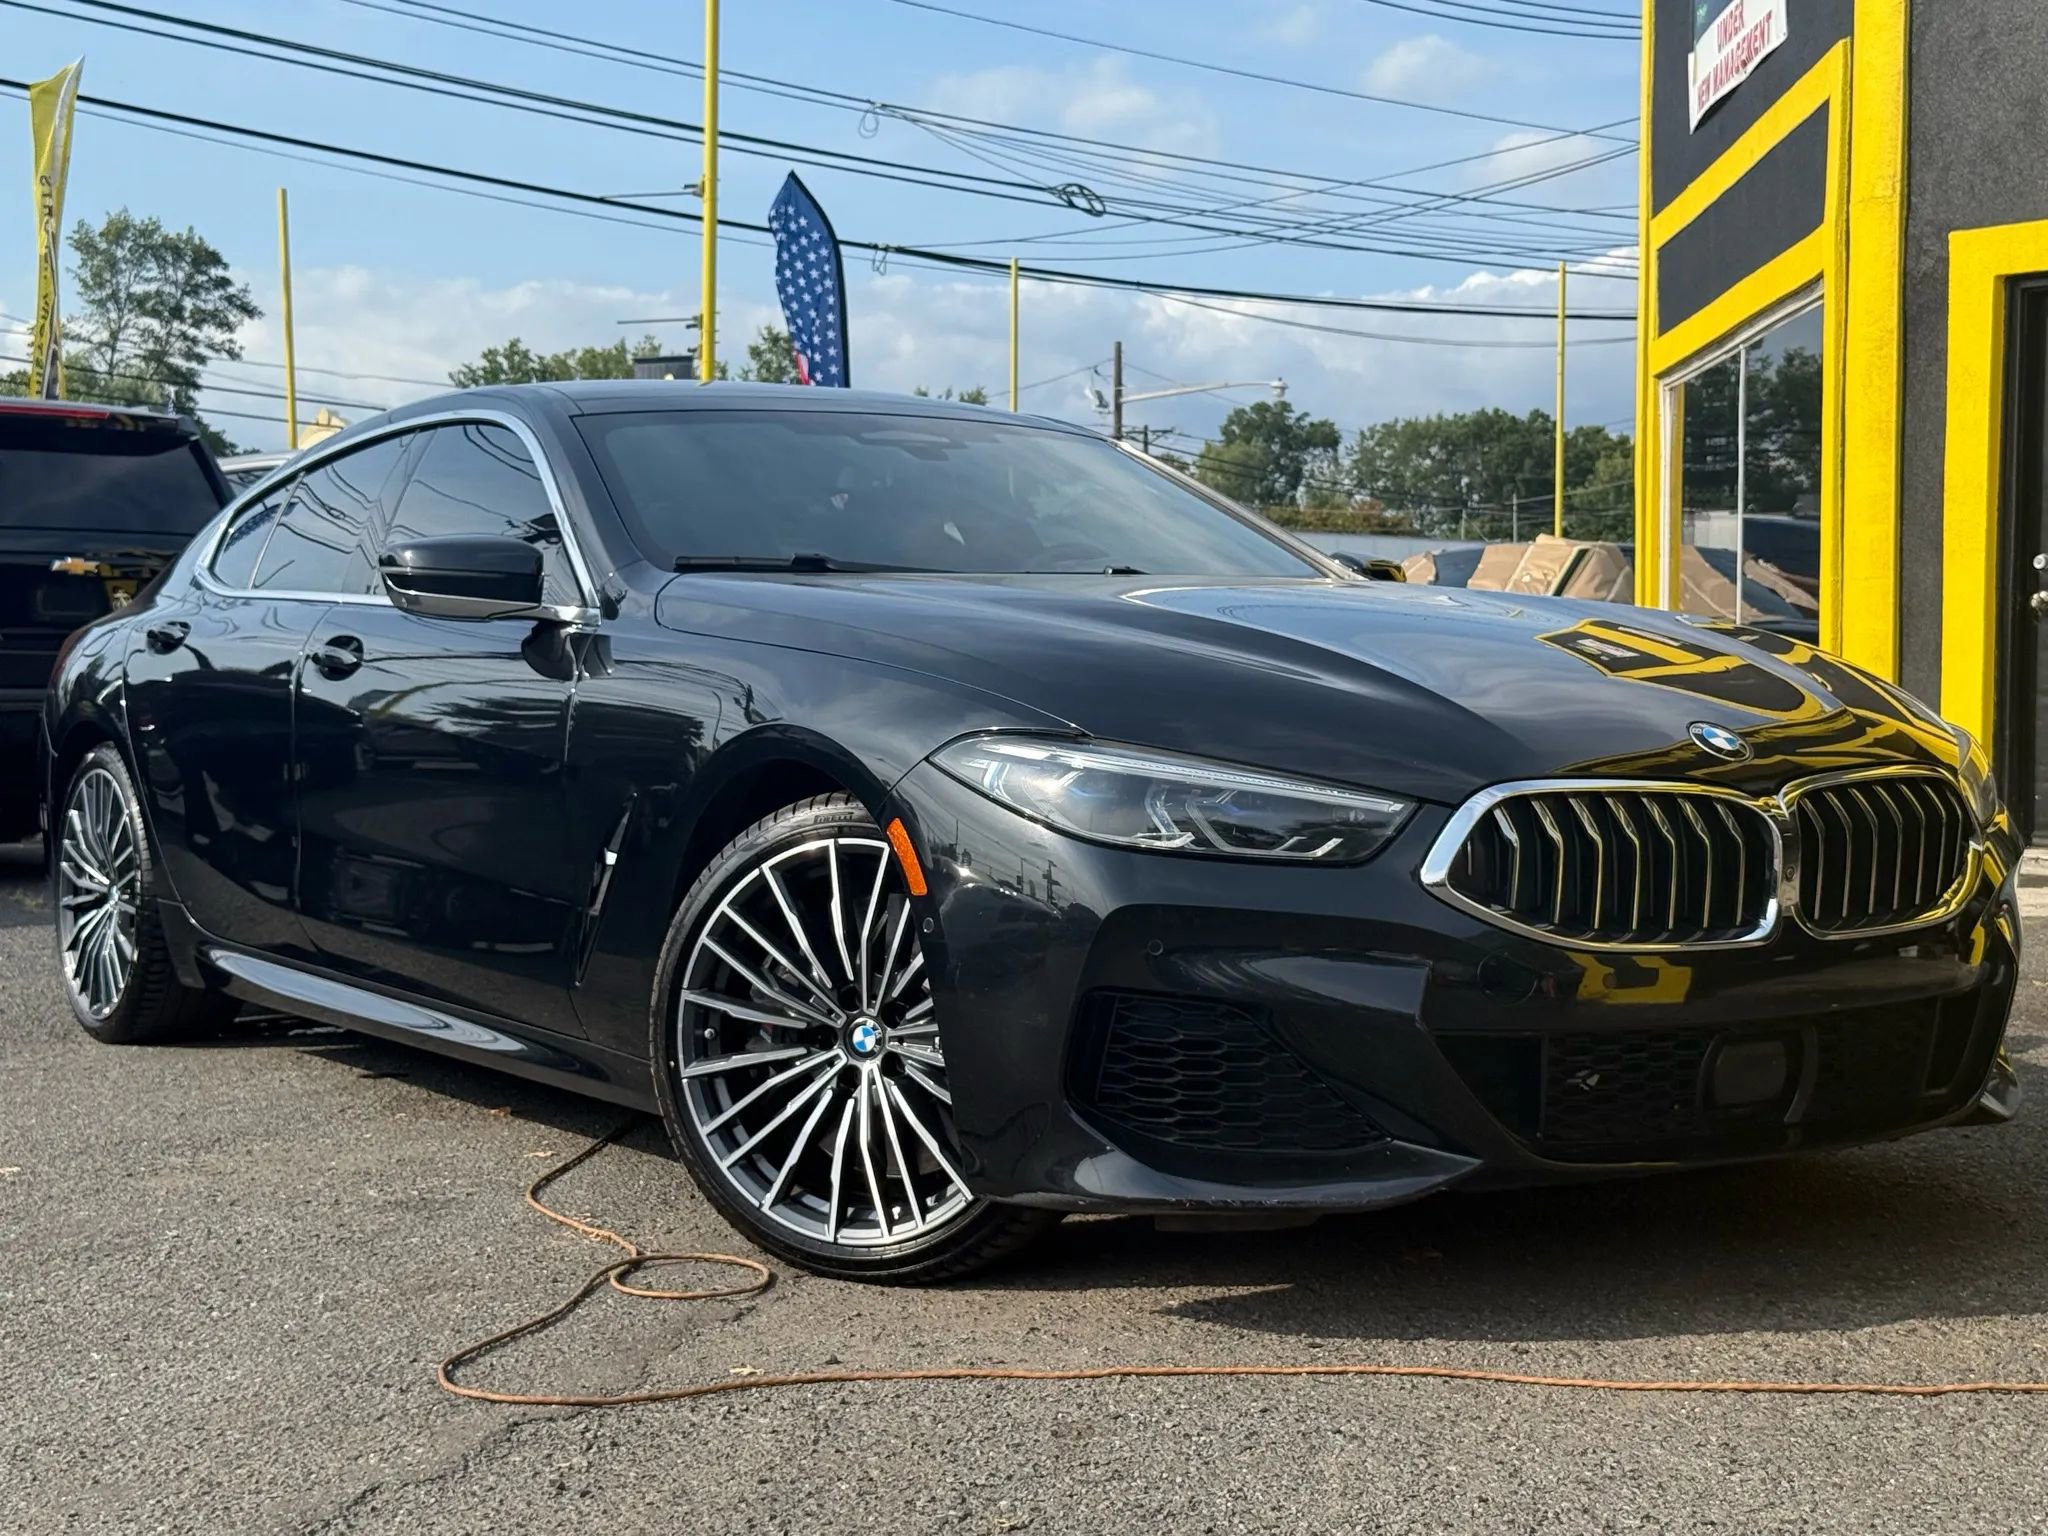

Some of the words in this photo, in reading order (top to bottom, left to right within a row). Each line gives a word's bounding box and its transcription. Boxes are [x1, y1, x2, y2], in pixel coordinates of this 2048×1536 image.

[1697, 71, 1712, 115] NEW
[1712, 9, 1773, 97] MANAGEMENT
[1716, 0, 1745, 54] UNDER
